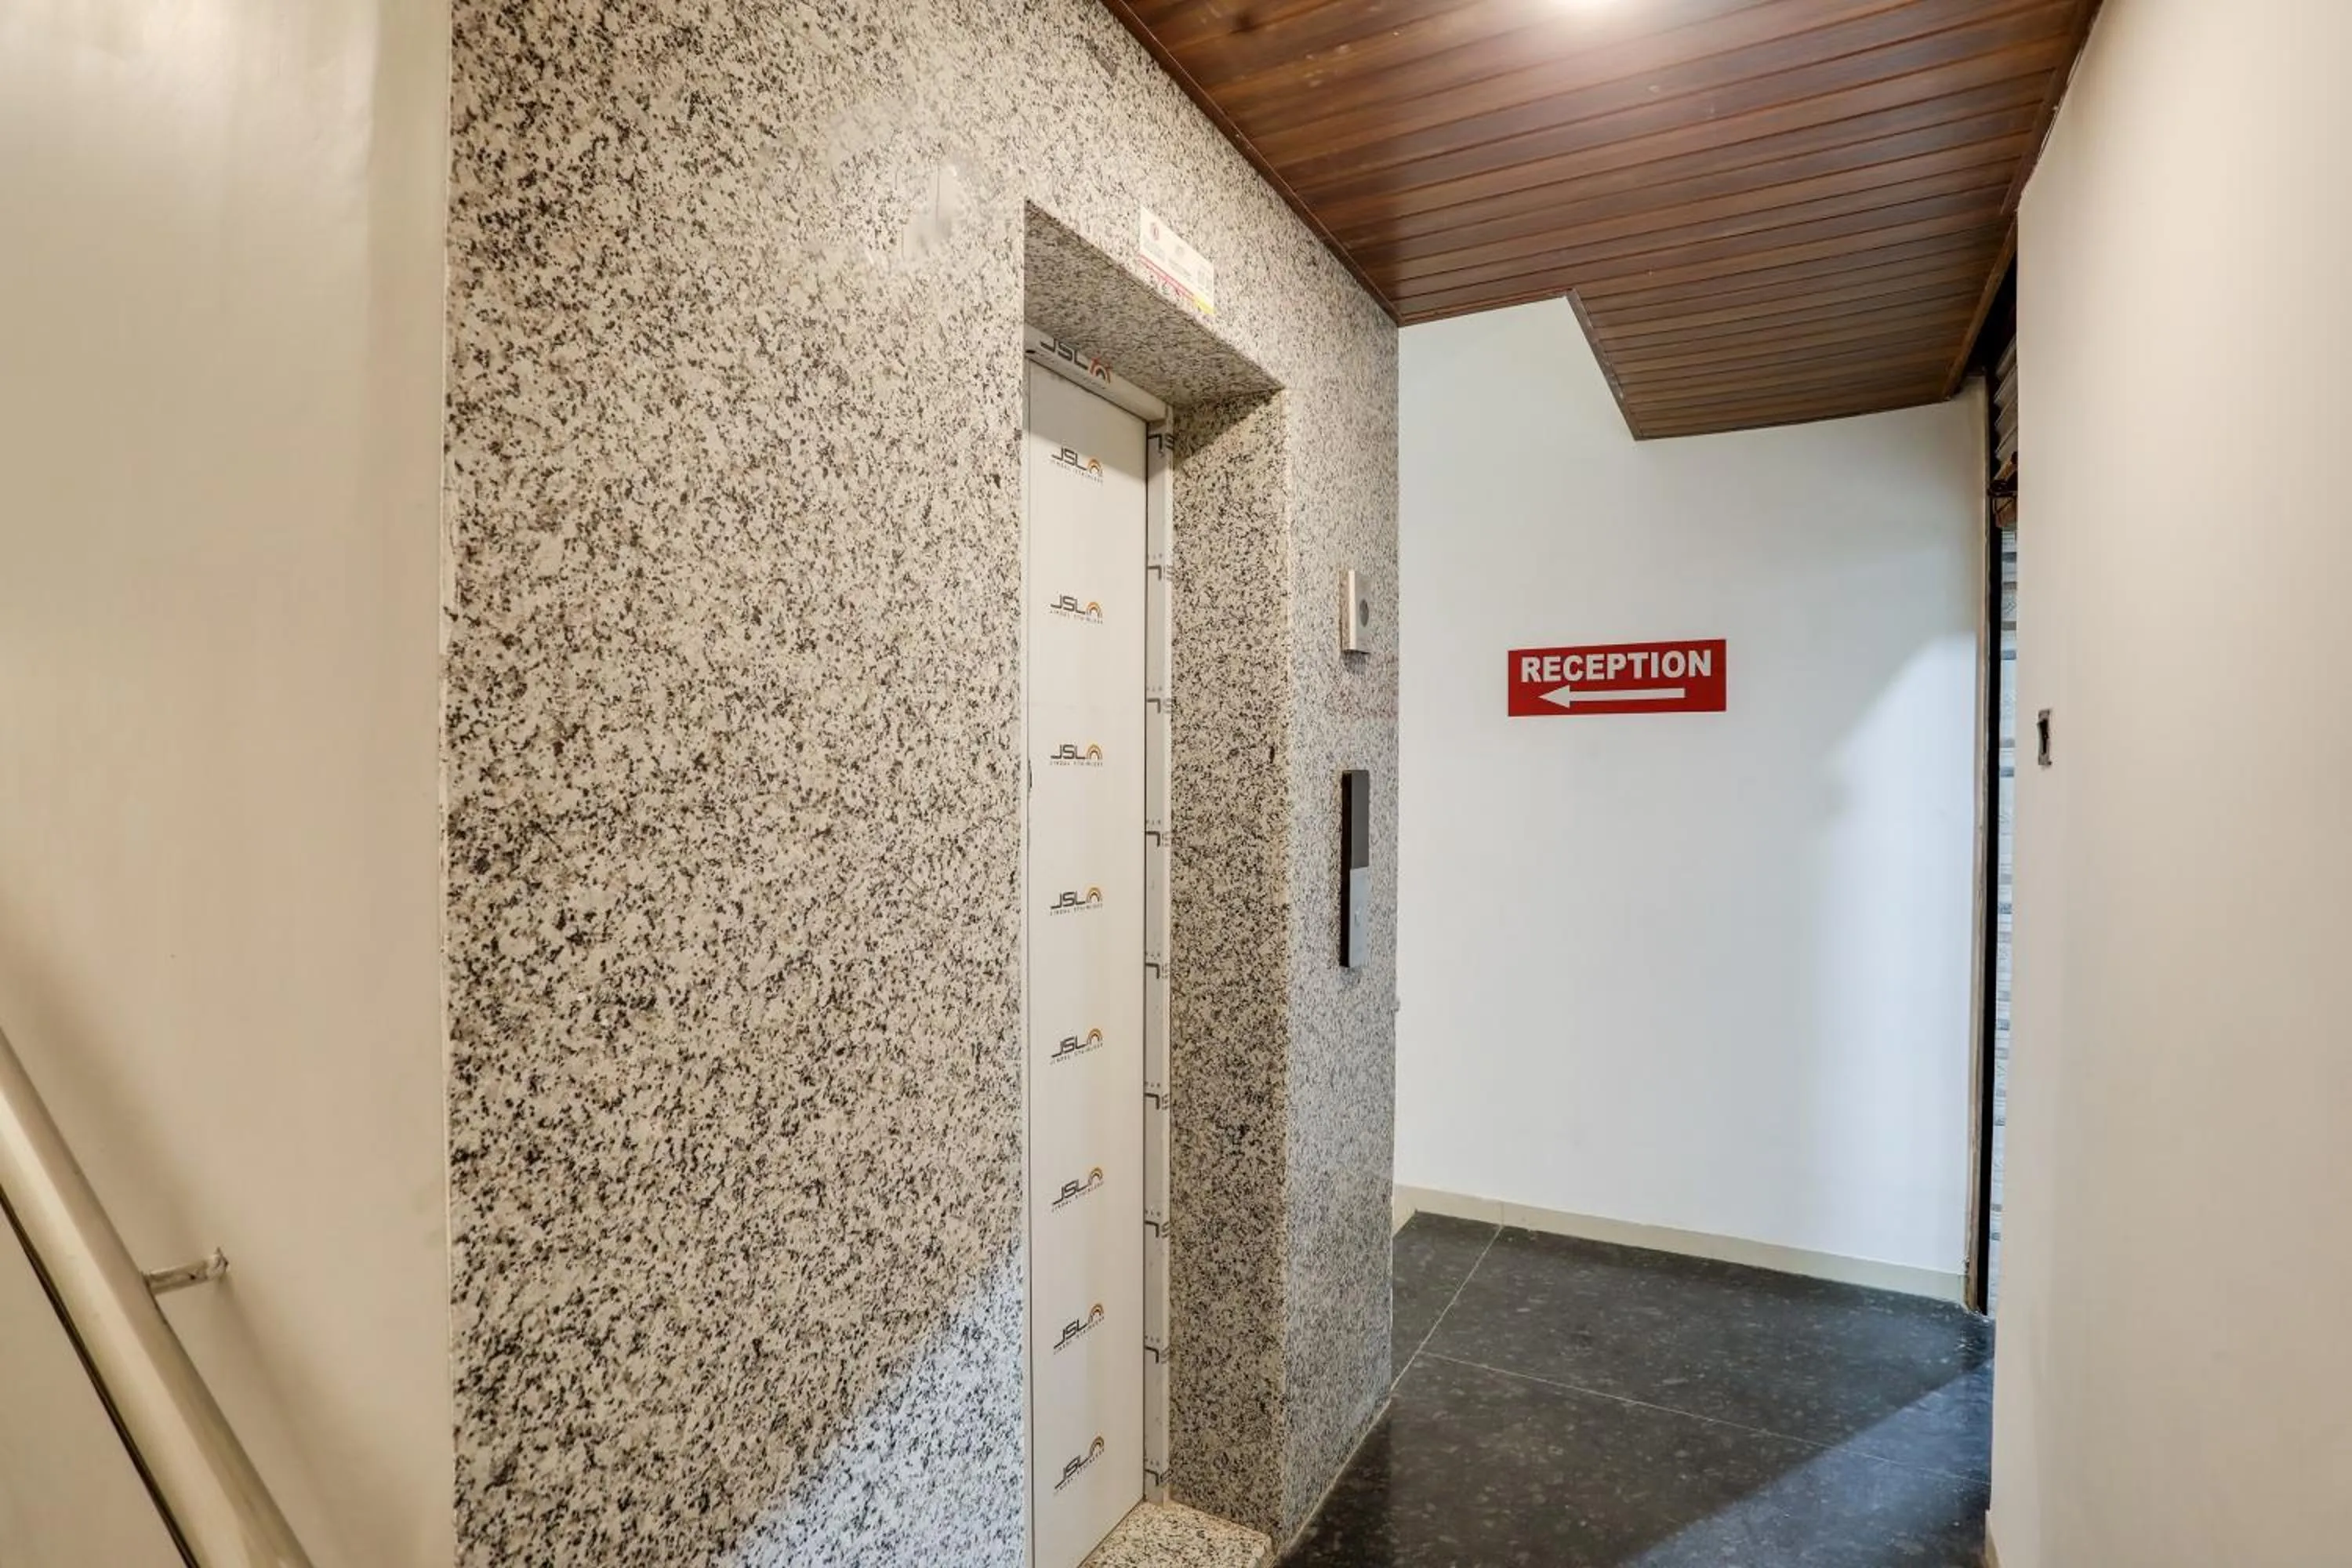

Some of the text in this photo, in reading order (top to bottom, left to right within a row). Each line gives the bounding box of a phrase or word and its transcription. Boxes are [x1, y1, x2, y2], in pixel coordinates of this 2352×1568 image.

[1051, 445, 1087, 471] JSL
[1050, 593, 1086, 615] JSL
[1521, 650, 1711, 682] RECEPTION
[1050, 744, 1086, 760] JSL
[1050, 890, 1086, 909] JSL
[1051, 1035, 1087, 1058] JSL
[1052, 1179, 1089, 1205] JSL
[1054, 1319, 1087, 1349] JSL
